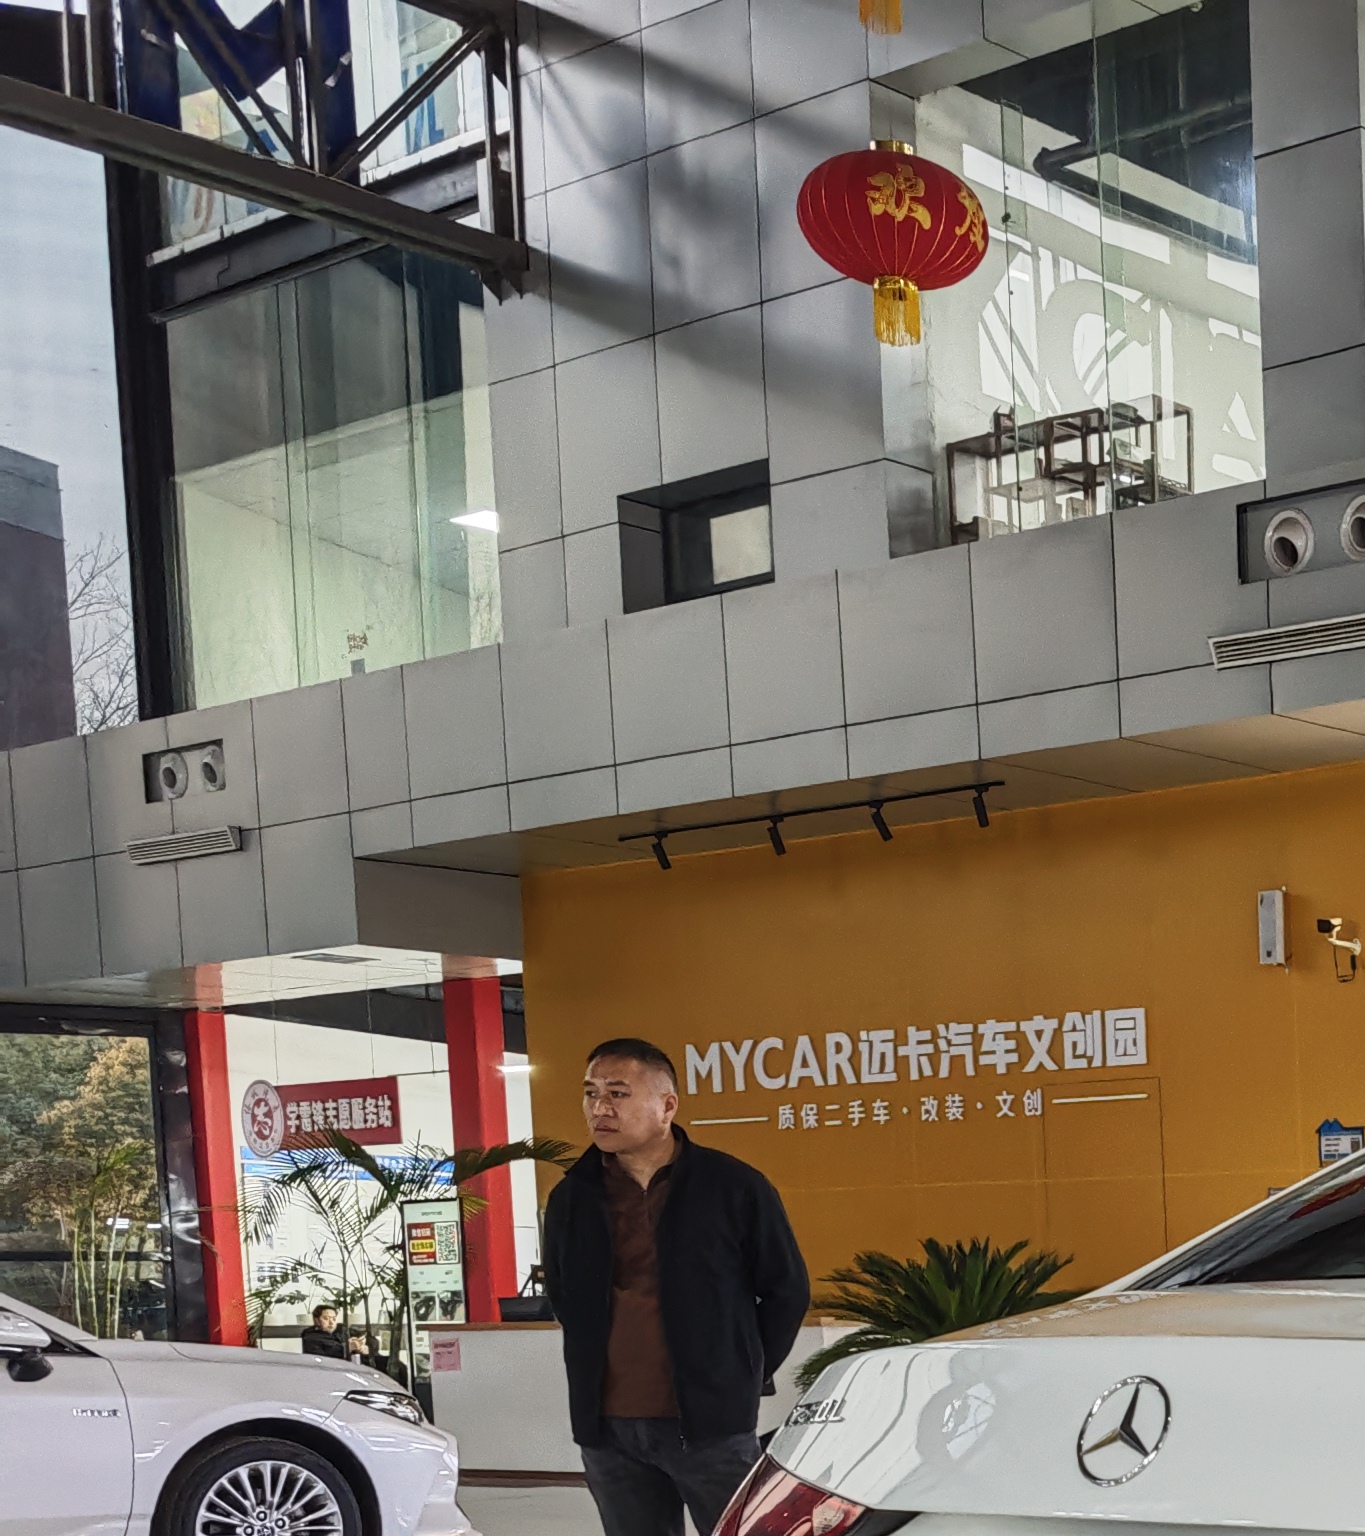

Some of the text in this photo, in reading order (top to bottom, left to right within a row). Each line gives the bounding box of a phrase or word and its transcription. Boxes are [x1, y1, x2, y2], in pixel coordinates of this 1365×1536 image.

[684, 1006, 1148, 1097] MYCAR迈卡汽车文创园
